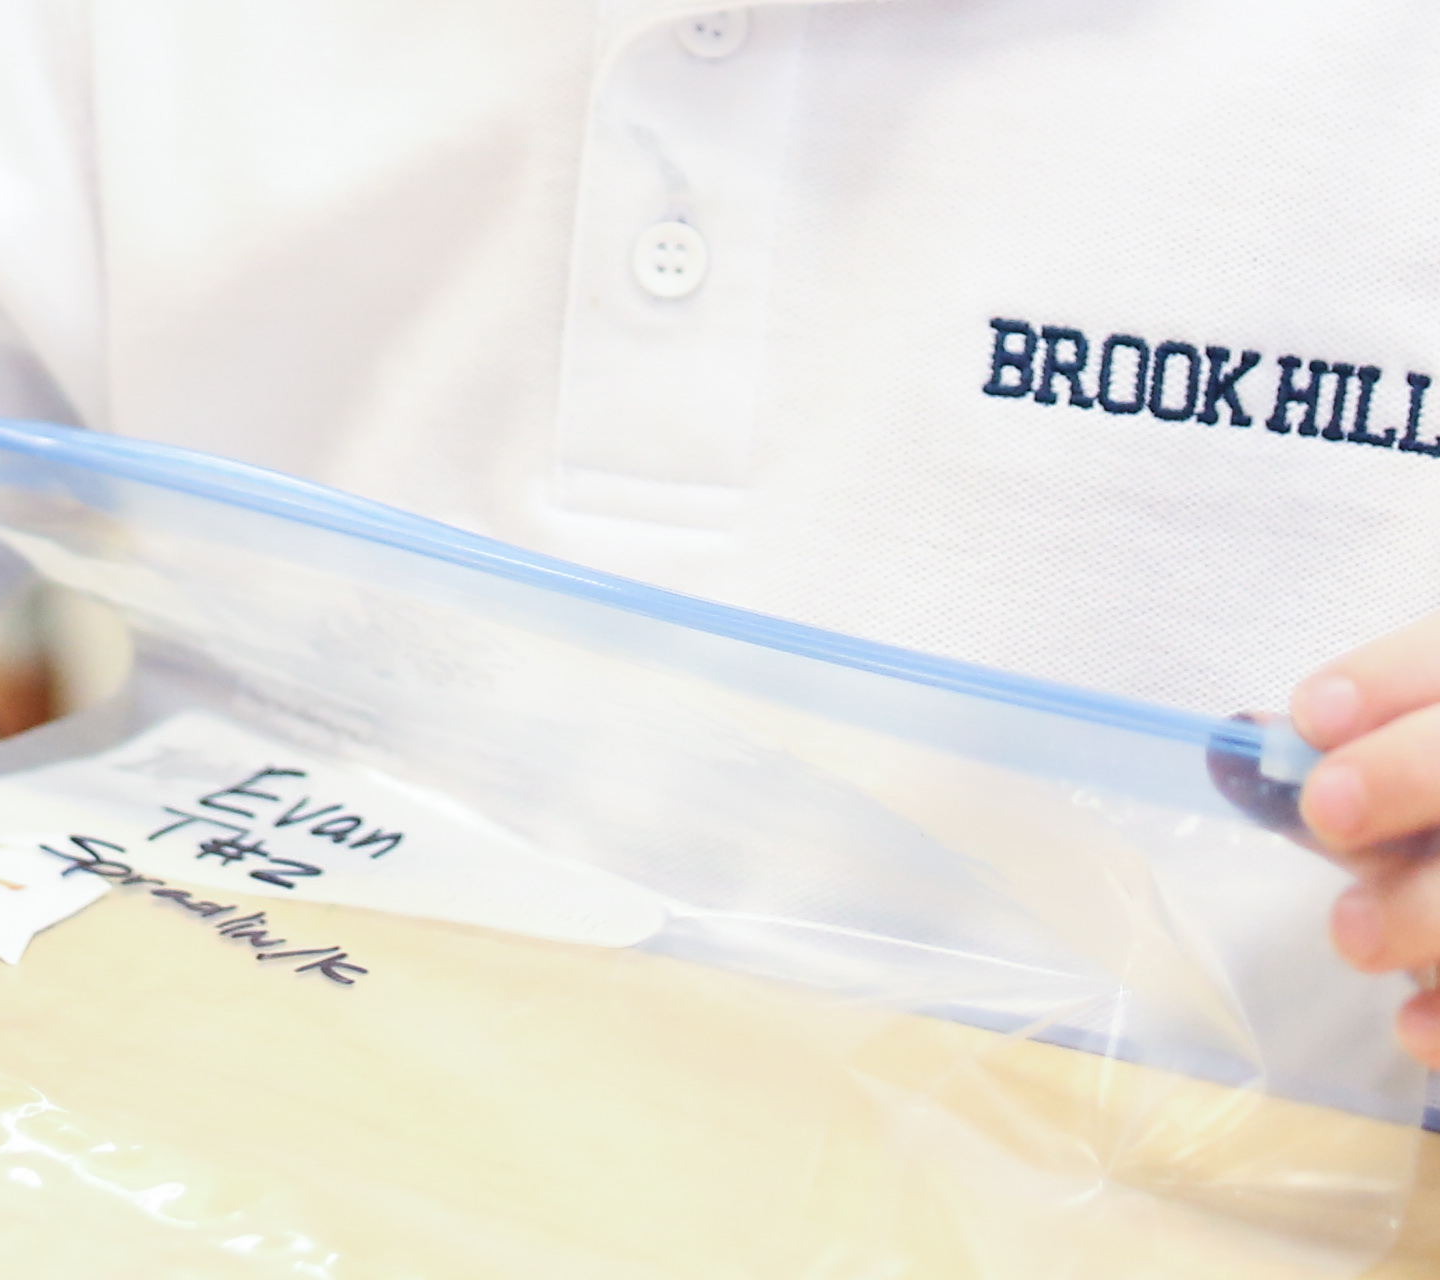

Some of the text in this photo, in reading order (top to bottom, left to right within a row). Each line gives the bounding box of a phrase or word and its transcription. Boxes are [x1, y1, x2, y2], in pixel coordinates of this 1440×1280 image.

[982, 317, 1261, 428] BROOK
[146, 805, 323, 890] T#2
[199, 766, 403, 860] Evan
